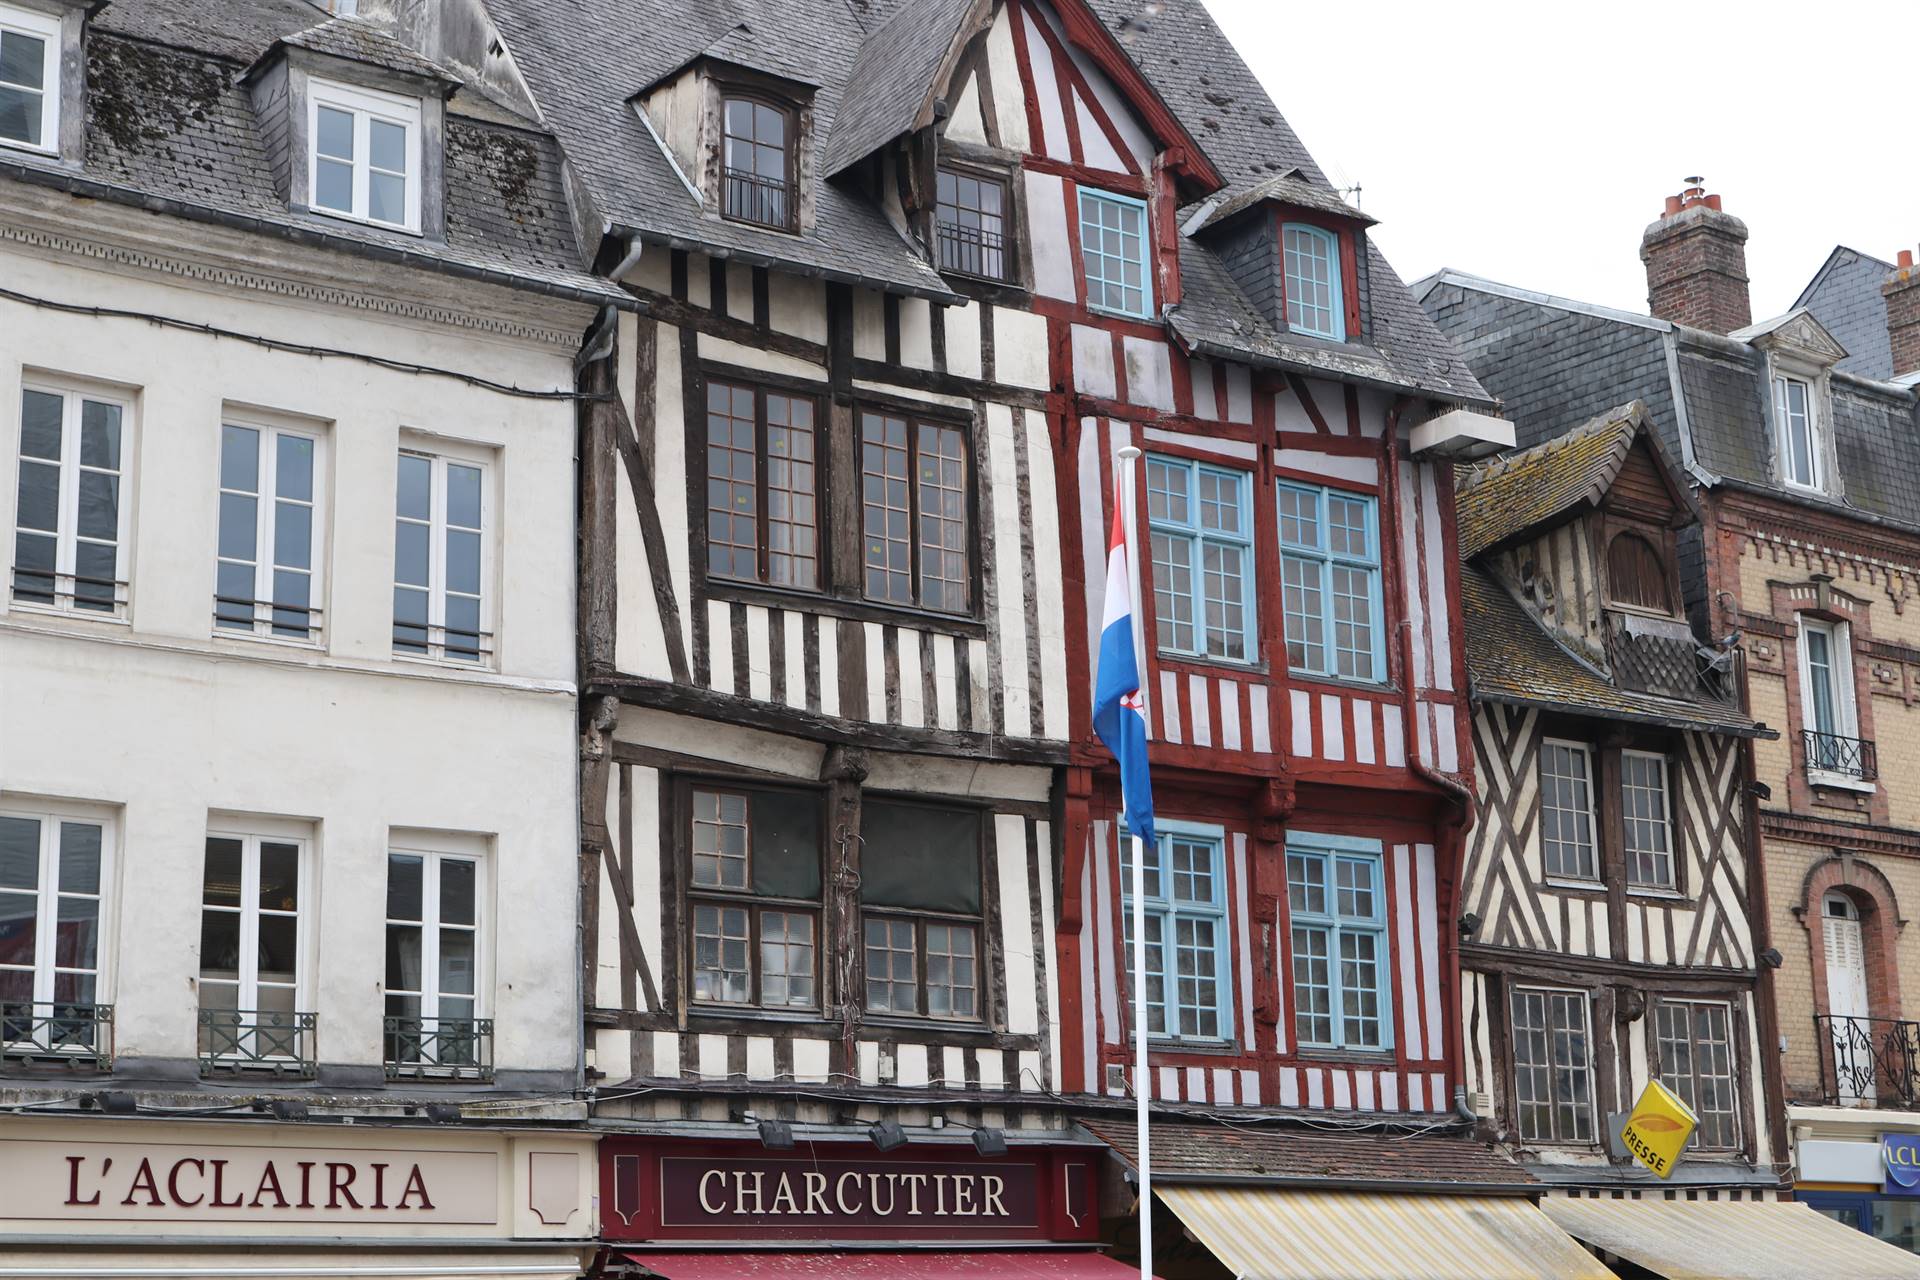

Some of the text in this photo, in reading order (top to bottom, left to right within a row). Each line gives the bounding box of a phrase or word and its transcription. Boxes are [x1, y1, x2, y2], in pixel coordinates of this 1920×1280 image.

[1625, 1126, 1666, 1171] PRESSE
[1887, 1146, 1920, 1165] LCL
[64, 1156, 436, 1210] L'ACLAIRIA
[699, 1169, 1010, 1217] CHARCUTIER
